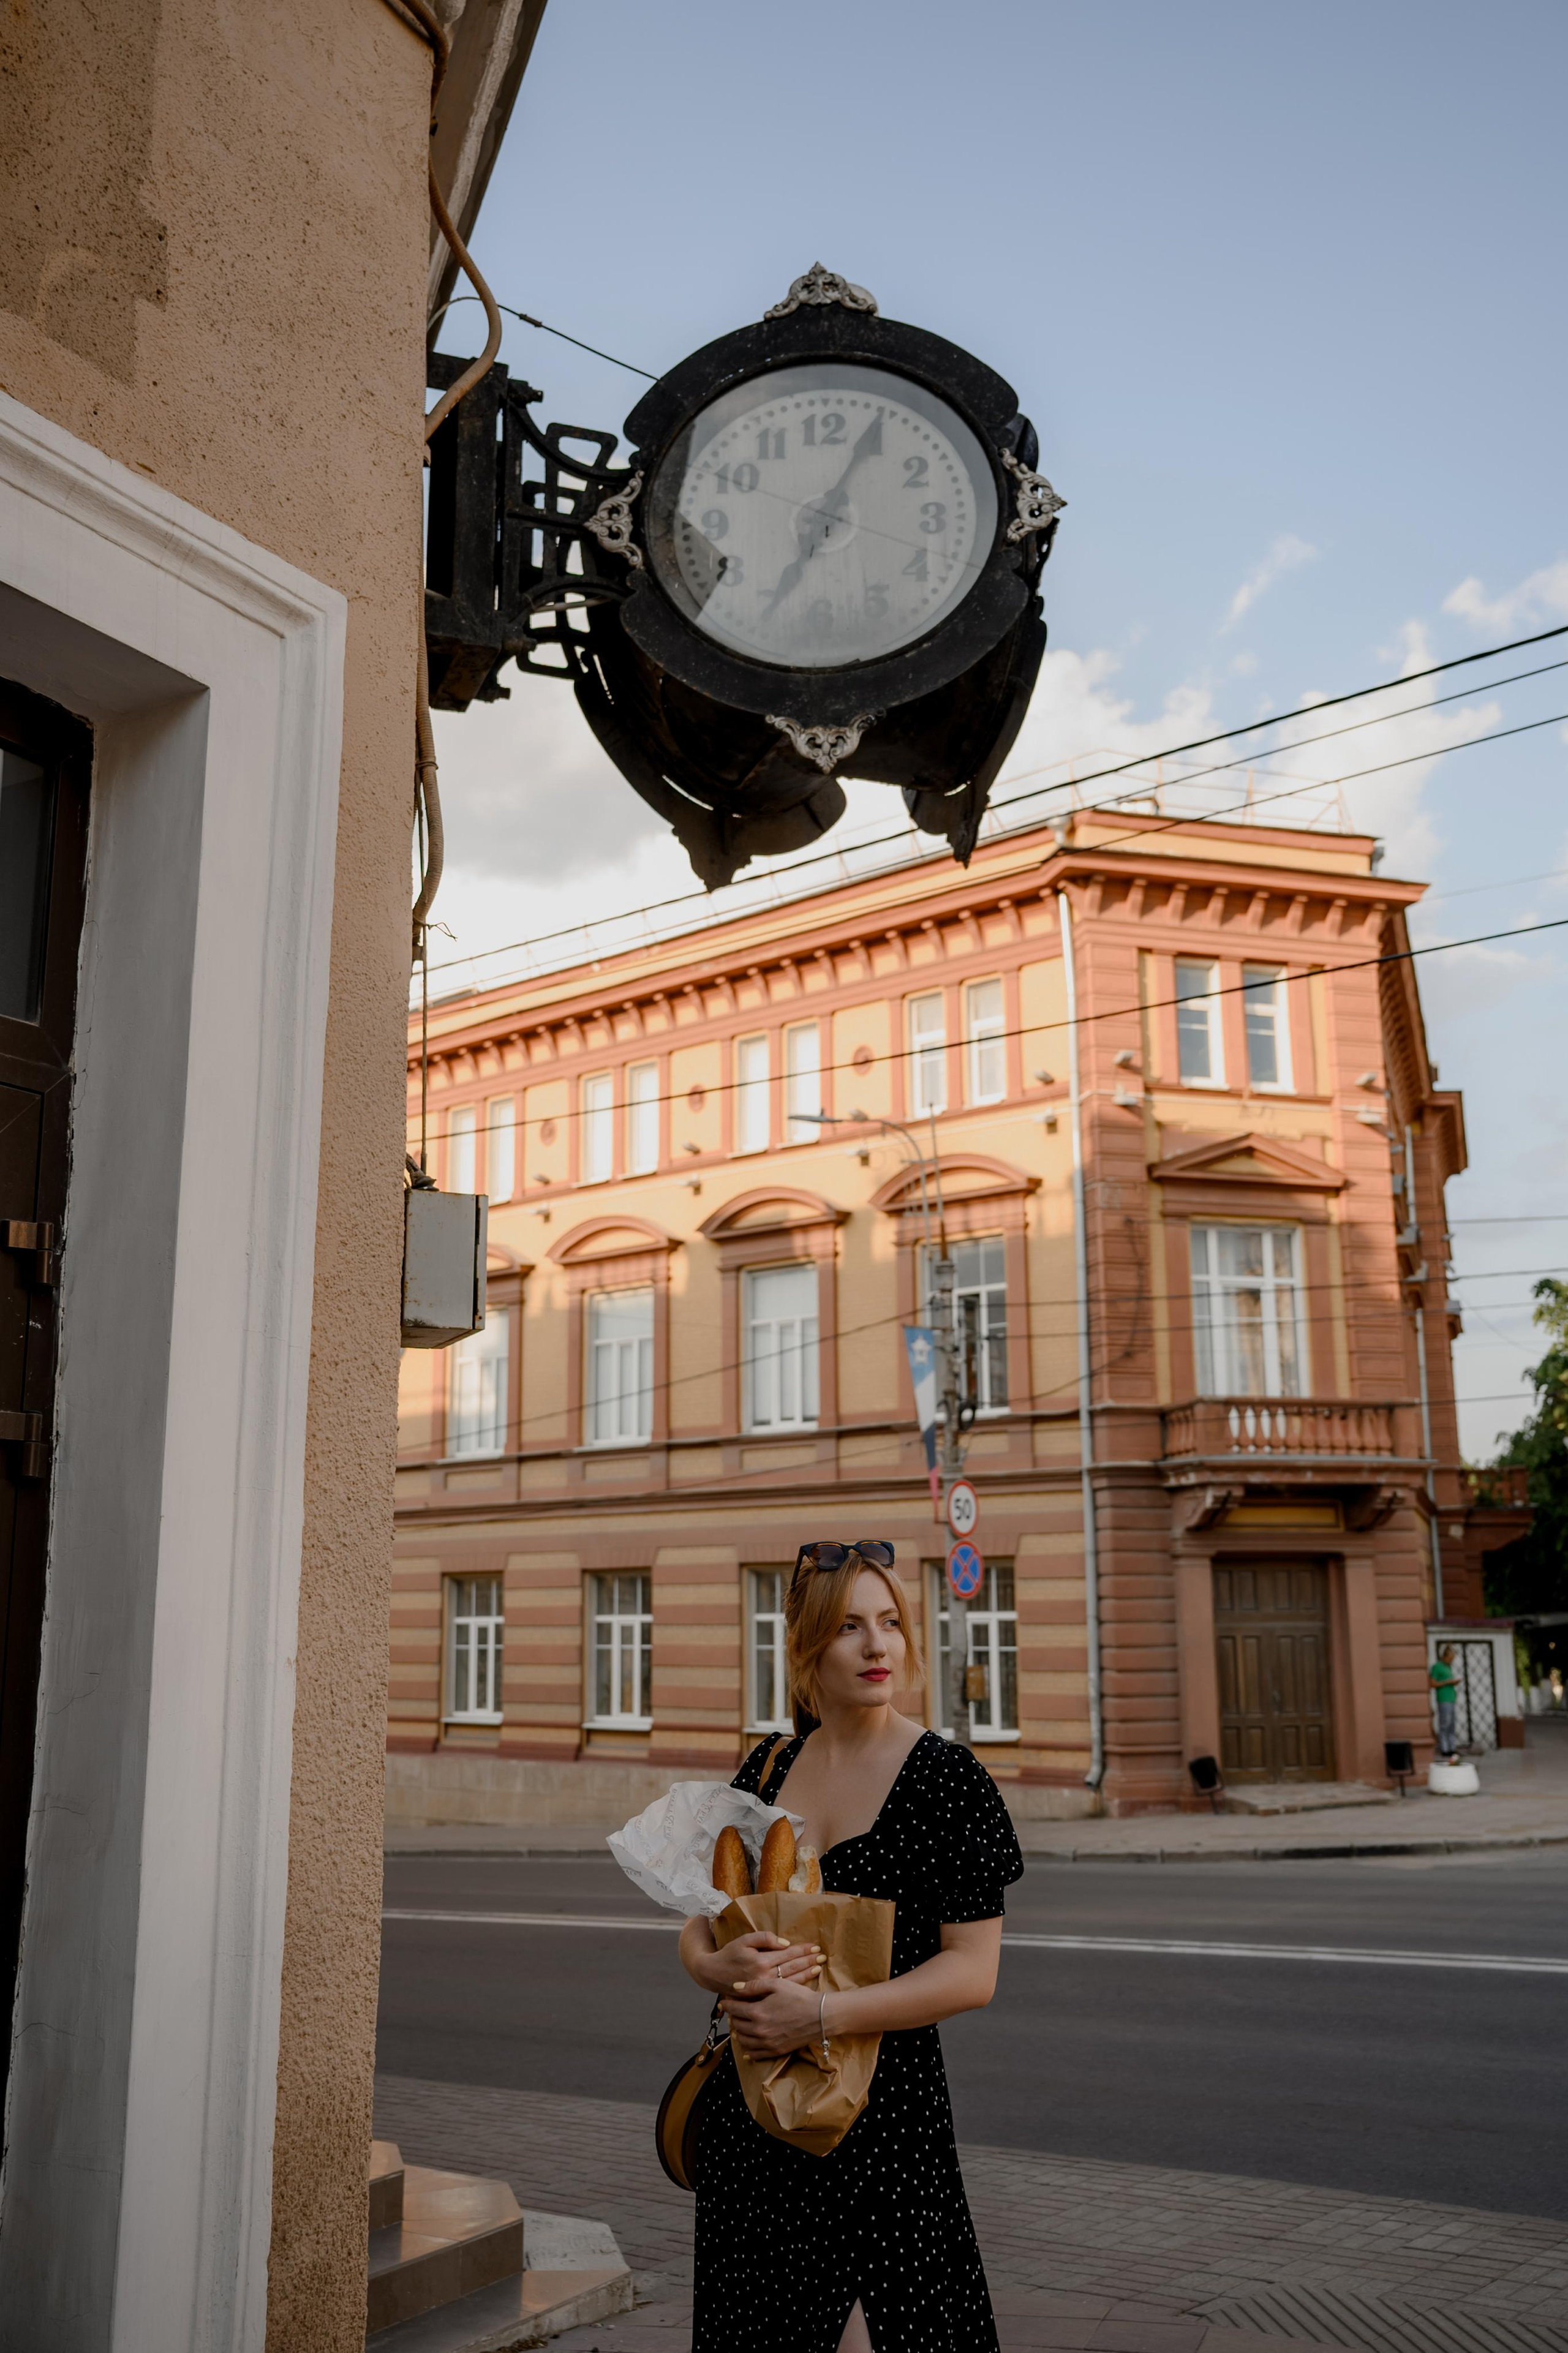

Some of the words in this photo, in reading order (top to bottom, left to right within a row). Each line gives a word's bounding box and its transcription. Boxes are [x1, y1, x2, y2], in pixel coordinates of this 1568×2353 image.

[755, 427, 786, 461] 11
[801, 412, 848, 446] 12
[714, 462, 760, 494] 10
[902, 456, 930, 489] 2
[701, 509, 729, 541] 9
[919, 502, 947, 534] 3
[717, 555, 744, 587] 8
[902, 548, 930, 582] 4
[864, 582, 890, 620] 5
[955, 1498, 972, 1521] 50
